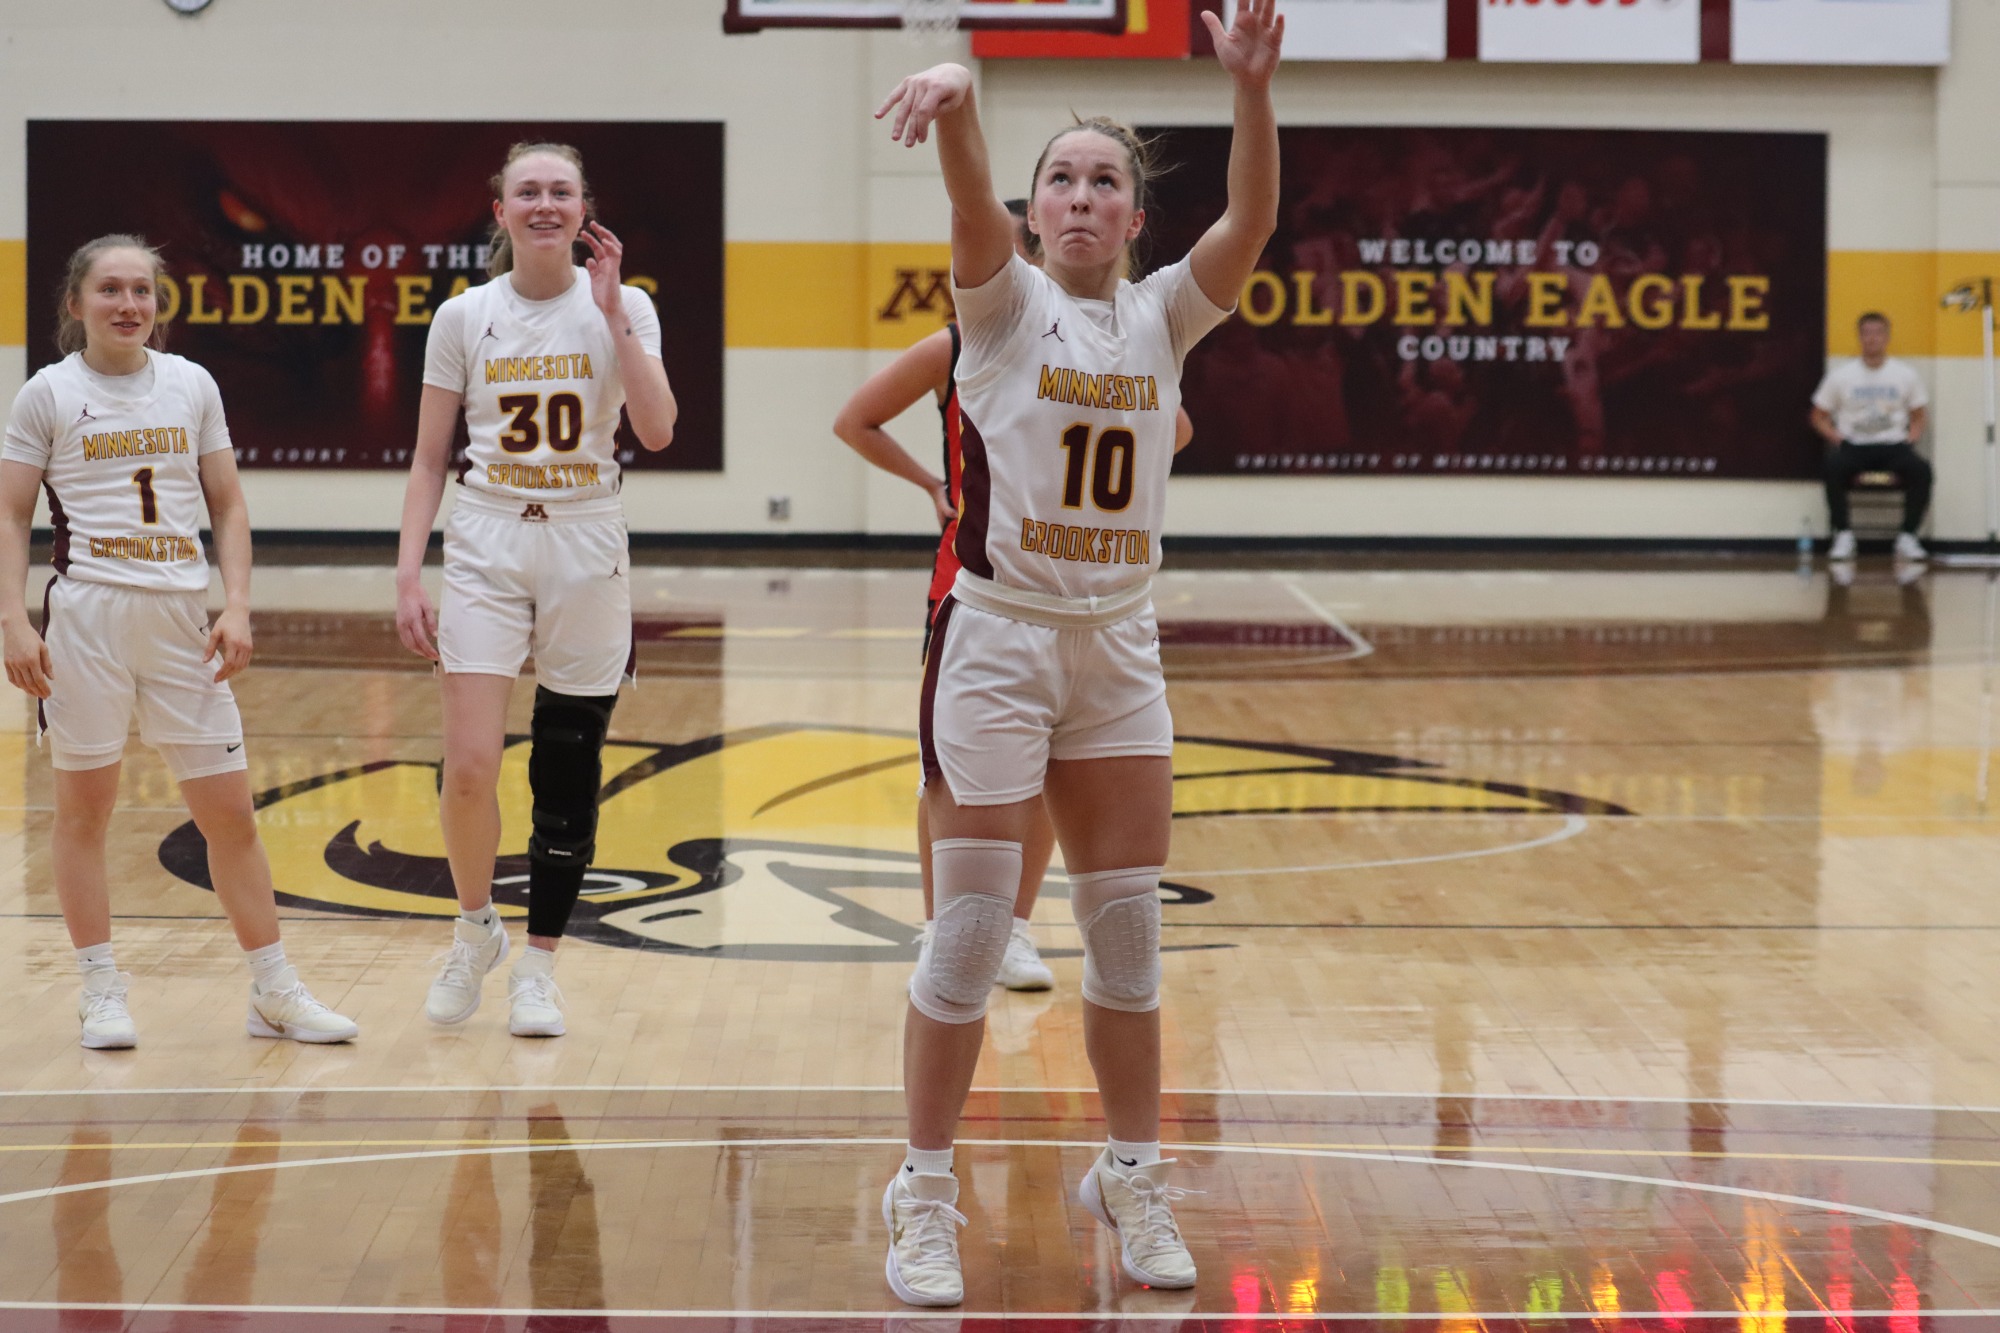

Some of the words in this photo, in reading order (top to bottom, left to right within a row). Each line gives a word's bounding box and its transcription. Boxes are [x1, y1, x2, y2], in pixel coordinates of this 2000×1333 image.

[242, 244, 344, 268] HOME
[361, 244, 406, 269] OF
[423, 244, 491, 269] THE
[1358, 239, 1537, 265] WELCOME
[1552, 240, 1599, 266] TO
[155, 275, 368, 324] OLDEN
[1222, 270, 1498, 327] OLDEN
[1525, 273, 1770, 330] EAGLE
[485, 353, 593, 384] MINNESOTA
[1397, 335, 1570, 362] COUNTRY
[1037, 364, 1159, 411] MINNESOTA
[498, 391, 584, 454] 30
[82, 427, 189, 461] MINNESOTA
[487, 463, 601, 489] CROOKSTON
[1059, 421, 1136, 514] 10
[131, 466, 159, 526] 1
[89, 536, 197, 562] CROOKSTON
[1020, 517, 1150, 564] CROOKSTON
